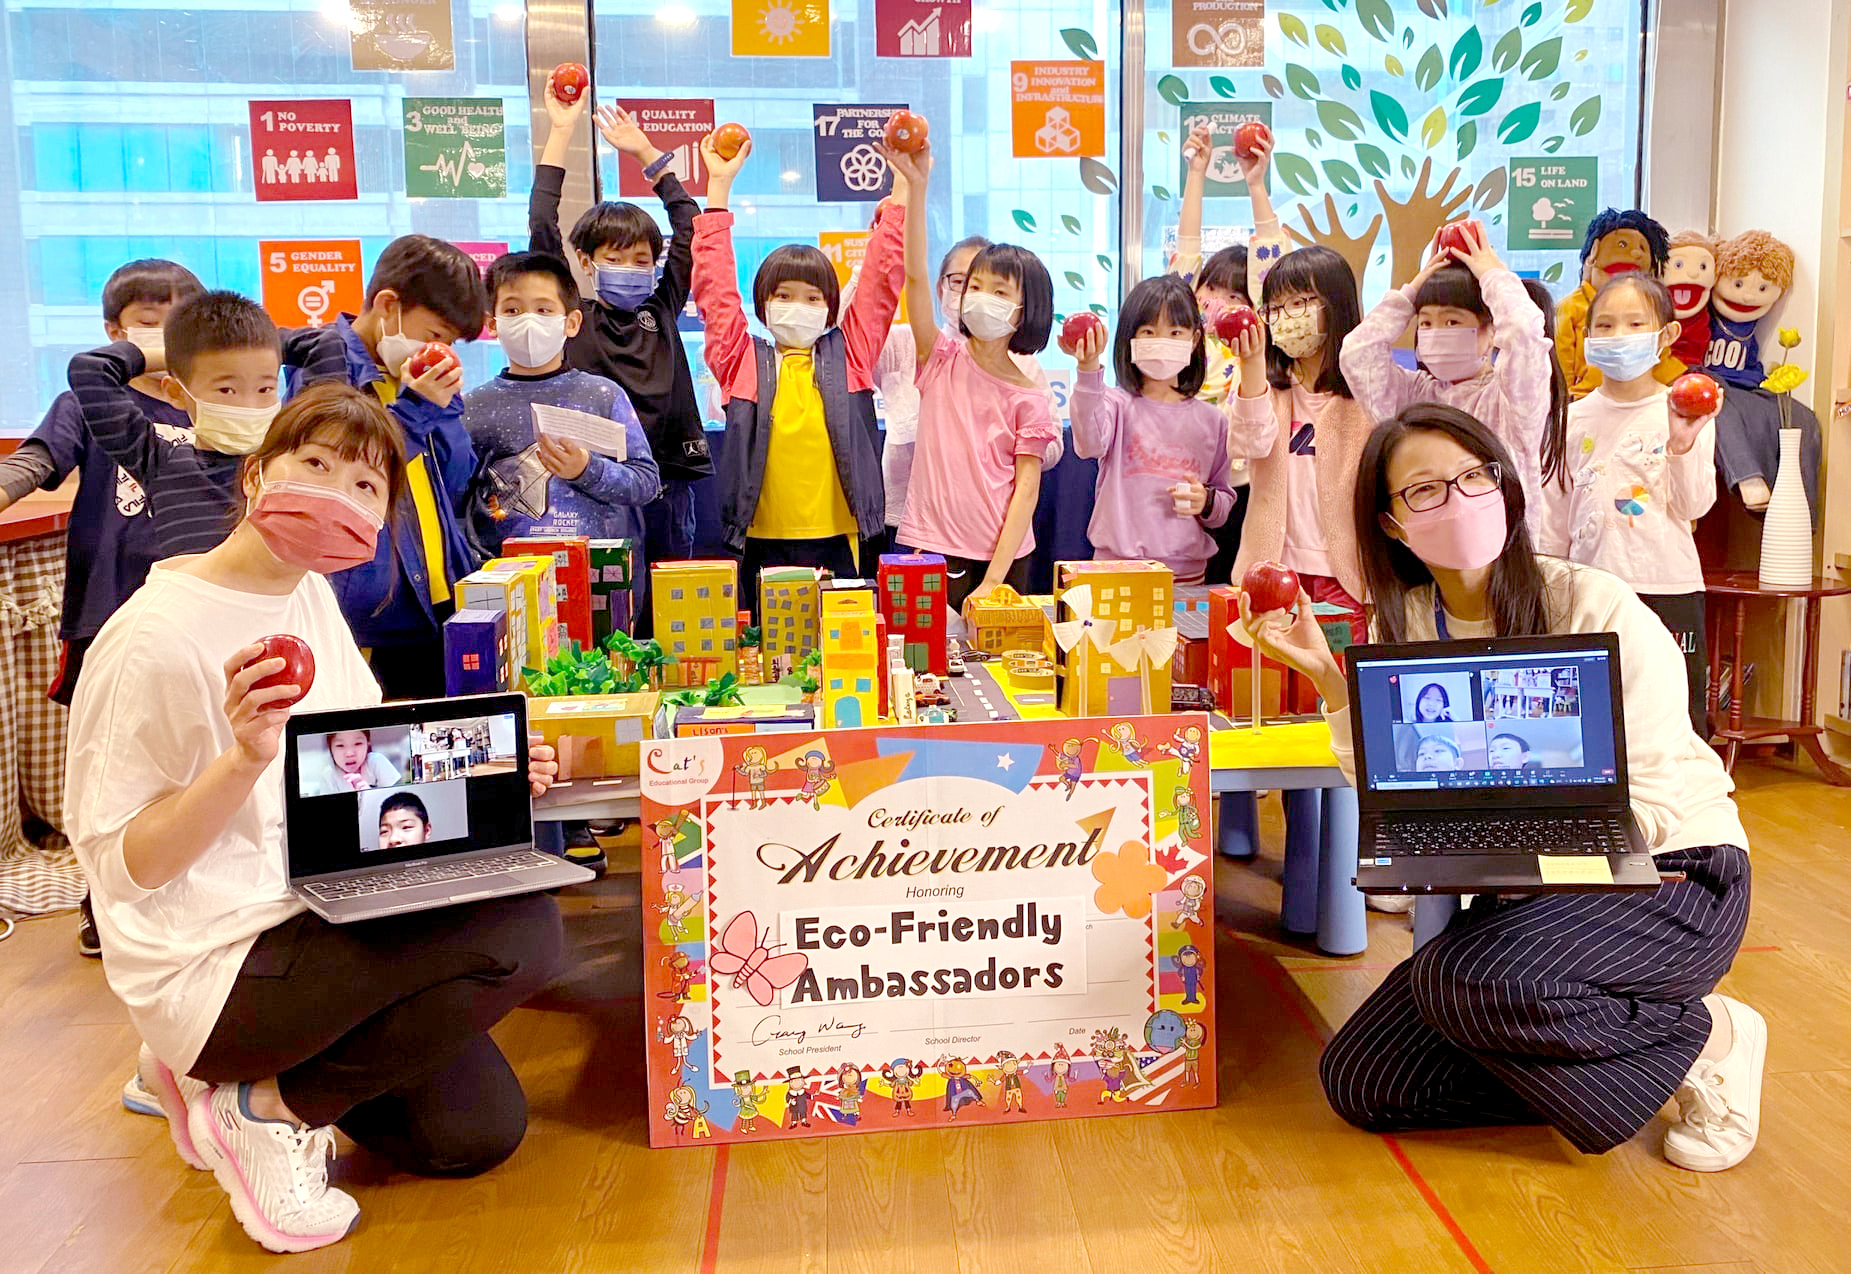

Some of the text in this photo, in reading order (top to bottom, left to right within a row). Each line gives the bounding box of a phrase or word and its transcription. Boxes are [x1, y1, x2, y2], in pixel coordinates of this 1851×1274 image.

[1193, 2, 1257, 11] PRODUCTION
[1034, 67, 1090, 76] INDUSTRY
[1012, 72, 1096, 92] 9 INNOVATION
[422, 105, 456, 115] GOOD
[641, 109, 697, 121] QUALITY
[260, 110, 297, 132] 1 NO
[404, 111, 468, 132] 3 and
[1211, 113, 1262, 123] CLIMATE
[279, 123, 340, 133] POVERTY
[423, 123, 503, 135] WELL BEING
[643, 122, 712, 132] EDUCATION
[814, 115, 880, 137] 17 FOR
[841, 128, 884, 138] THE GO
[1511, 166, 1566, 188] 15 LIFE
[1540, 179, 1588, 188] ON LAND
[269, 251, 343, 273] 5 GENDER
[292, 263, 356, 274] EQUALITY
[553, 511, 579, 519] GALAXY
[552, 519, 578, 527] ROCKET
[647, 748, 705, 777] Cat's
[649, 777, 709, 787] Educational Group
[868, 805, 1005, 831] Certificate of
[756, 827, 1104, 886] Achievement
[905, 885, 965, 899] Honoring
[795, 901, 1062, 950] Eco-Friendly
[790, 956, 1064, 1004] Ambassadors
[1068, 1027, 1086, 1036] Date
[924, 1034, 981, 1046] School Director
[778, 1045, 842, 1057] School President
